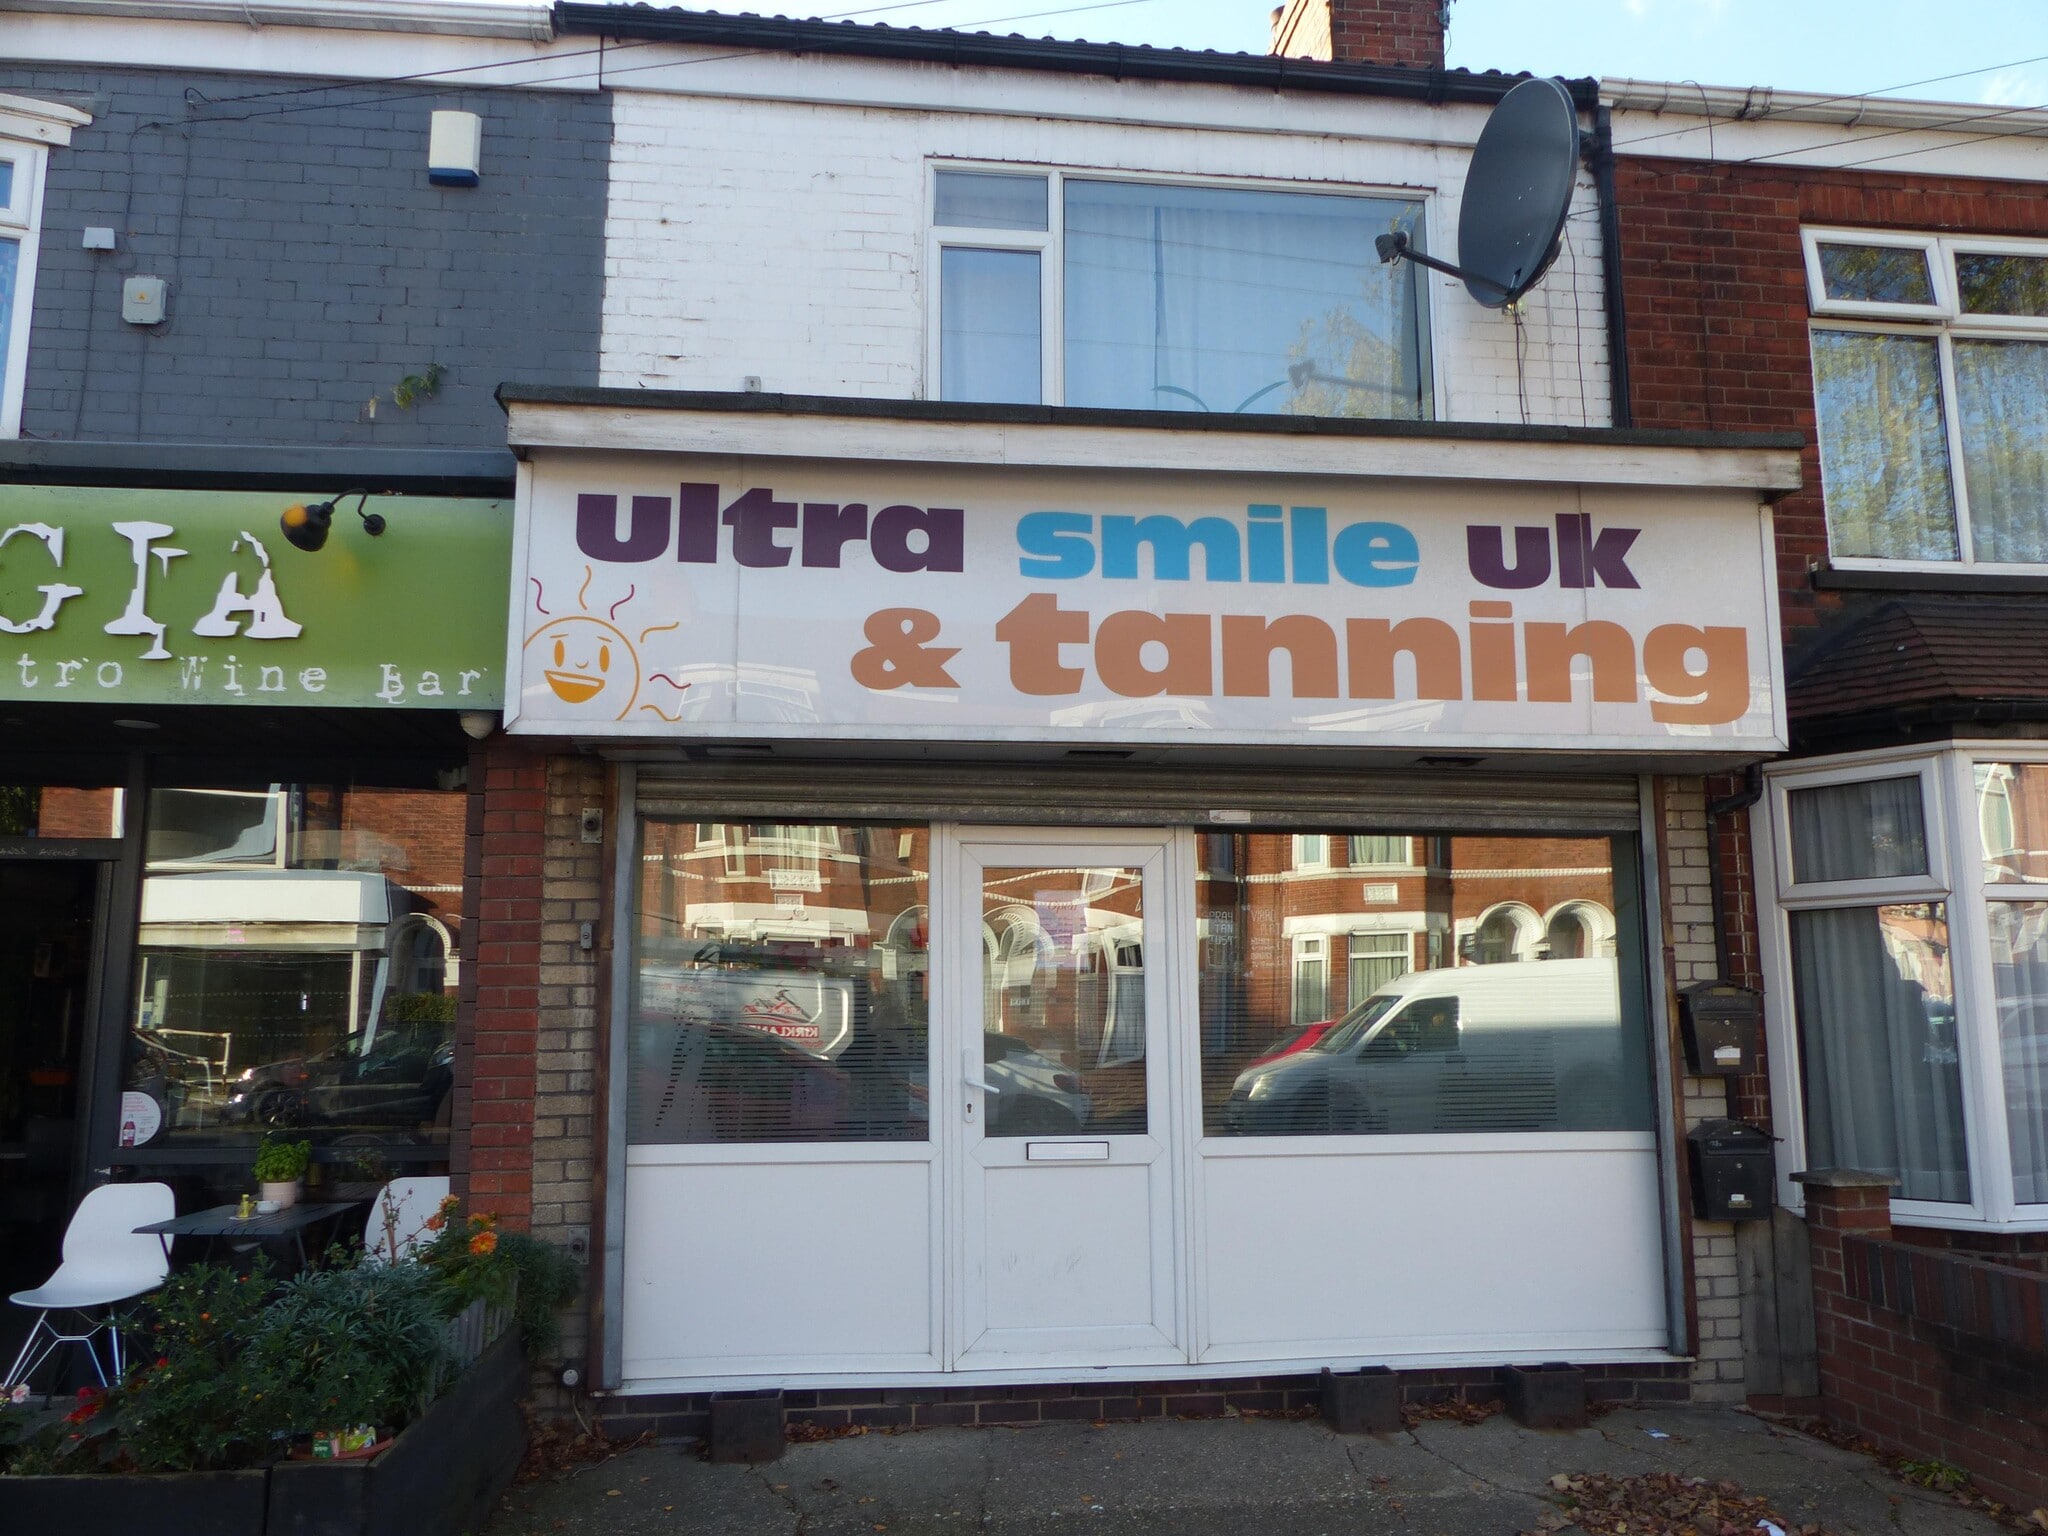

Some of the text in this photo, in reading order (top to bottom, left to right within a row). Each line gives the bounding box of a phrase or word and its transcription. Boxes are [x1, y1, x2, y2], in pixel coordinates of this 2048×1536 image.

[576, 482, 1642, 590] ultra smile uk
[180, 655, 328, 696] Wine
[376, 663, 488, 704] Bar
[850, 593, 1750, 726] & tanning
